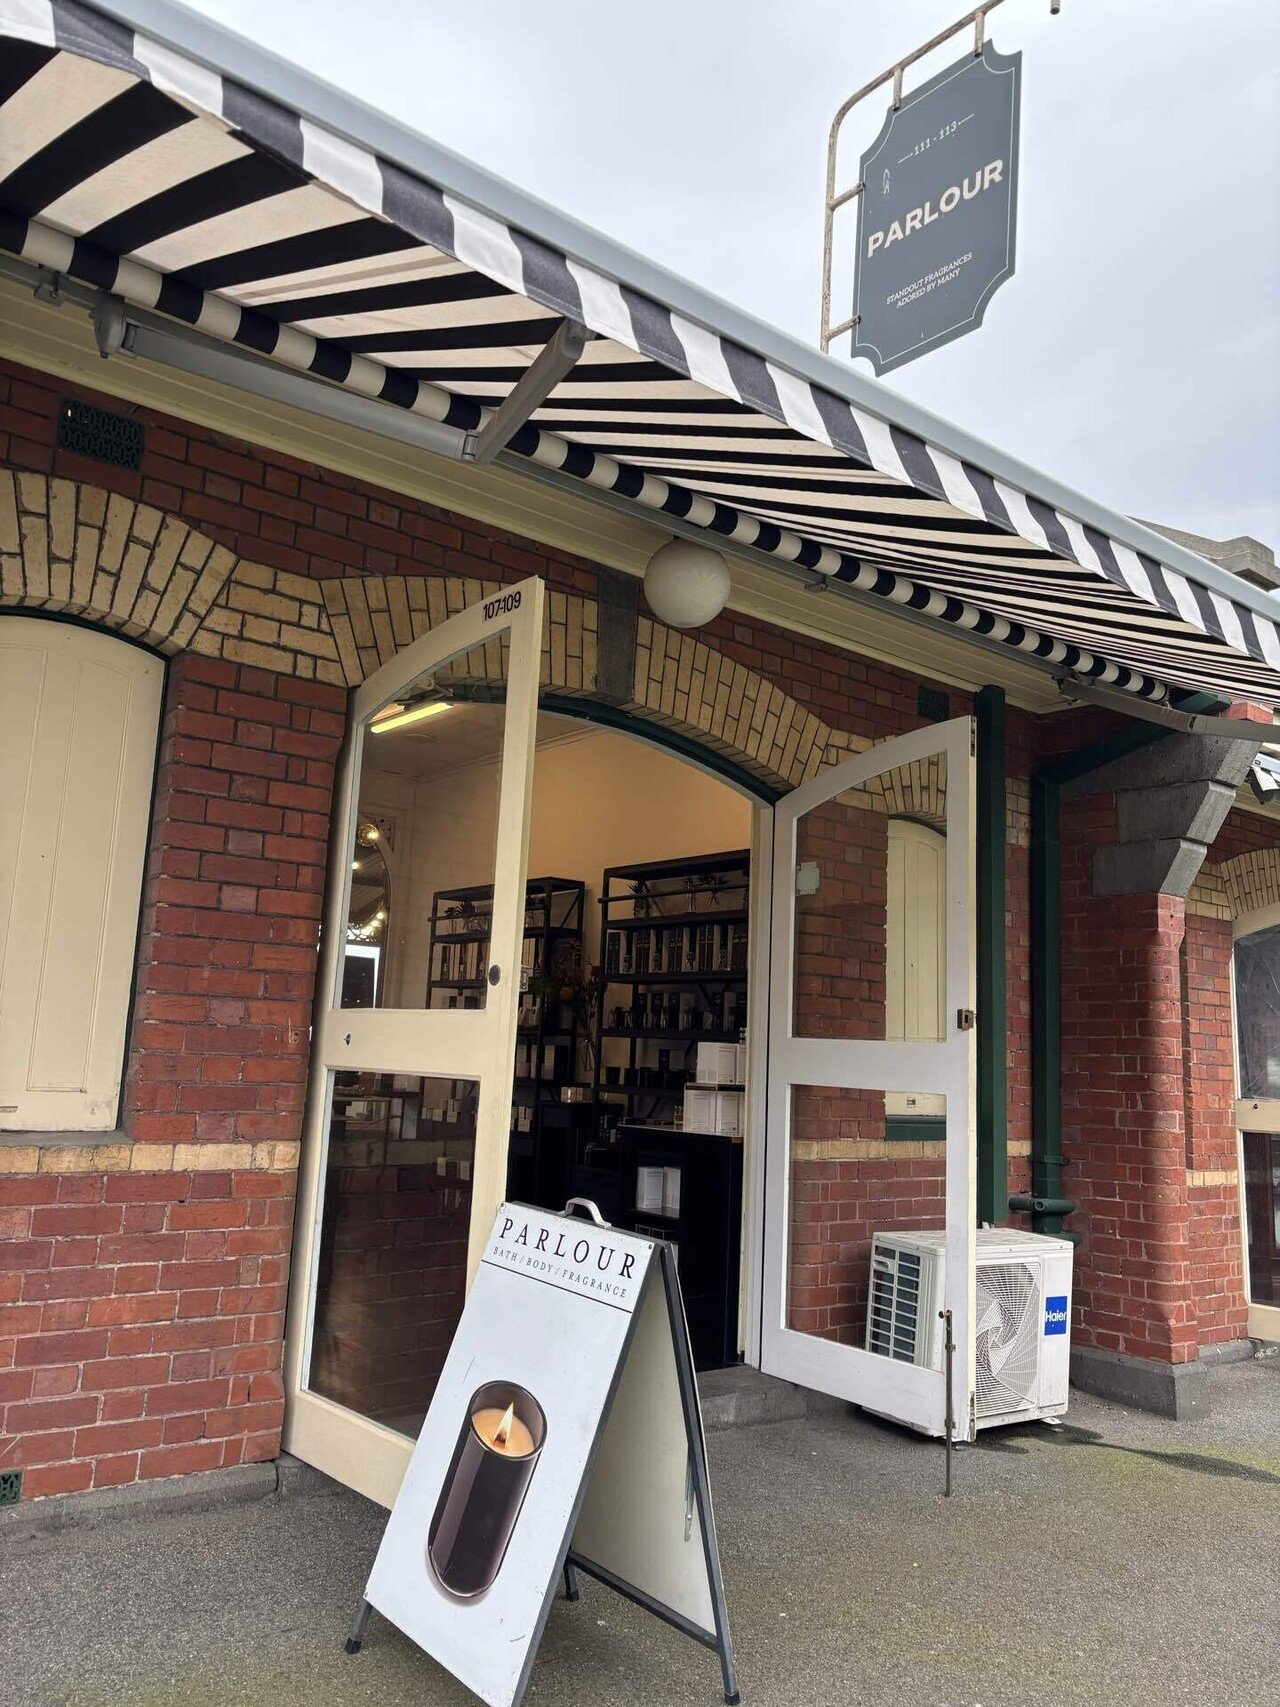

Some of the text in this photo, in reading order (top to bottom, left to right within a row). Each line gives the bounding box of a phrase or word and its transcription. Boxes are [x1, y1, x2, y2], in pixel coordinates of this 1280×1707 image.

[867, 159, 1004, 258] PARLOUR
[886, 251, 973, 305] STANDOUT FRAGRANCES
[896, 267, 960, 308] ADORED BY MANY
[483, 591, 522, 621] 107-109
[499, 1217, 636, 1280] PARLOUR
[1045, 1309, 1067, 1323] Haier
